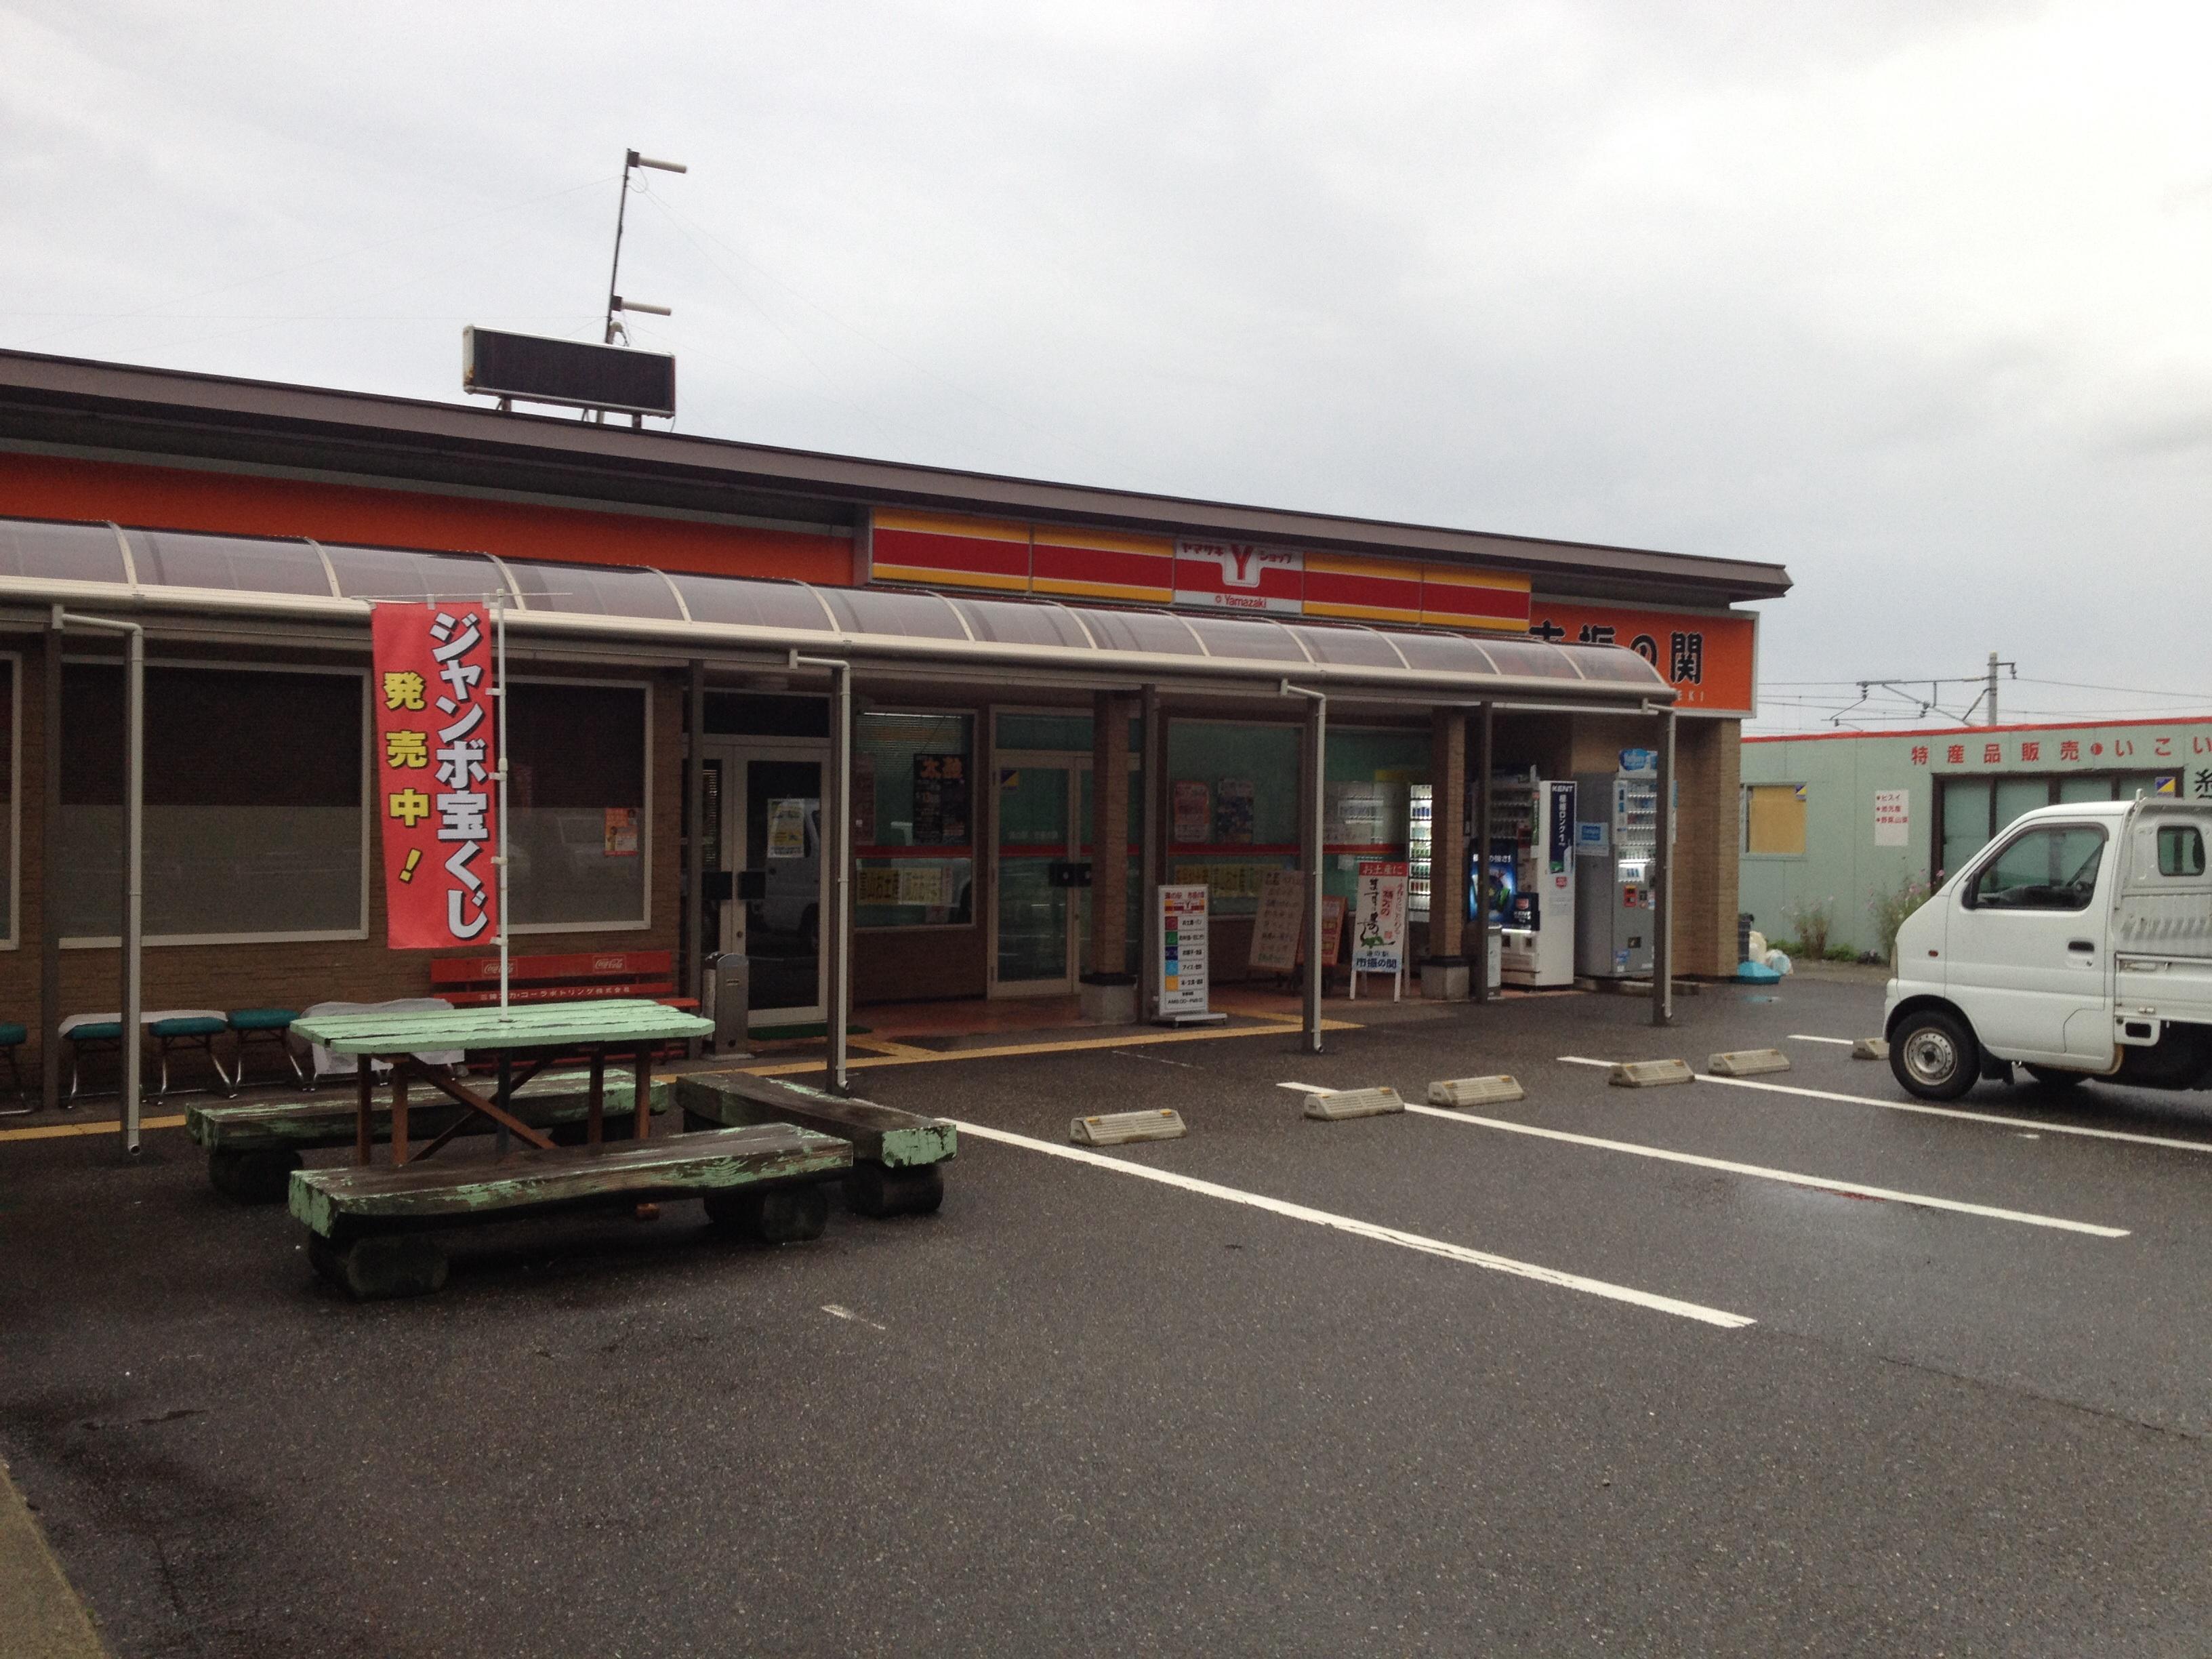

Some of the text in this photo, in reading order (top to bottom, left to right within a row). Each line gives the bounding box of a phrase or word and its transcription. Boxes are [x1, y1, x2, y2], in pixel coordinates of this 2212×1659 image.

[1231, 543, 1254, 580] Y
[1225, 594, 1267, 609] Yamazaki
[383, 670, 430, 883] 発売中!
[429, 611, 489, 940] ジャンボ宝くじ
[1362, 865, 1403, 876] お土産に
[595, 958, 624, 970] Coca-Cola
